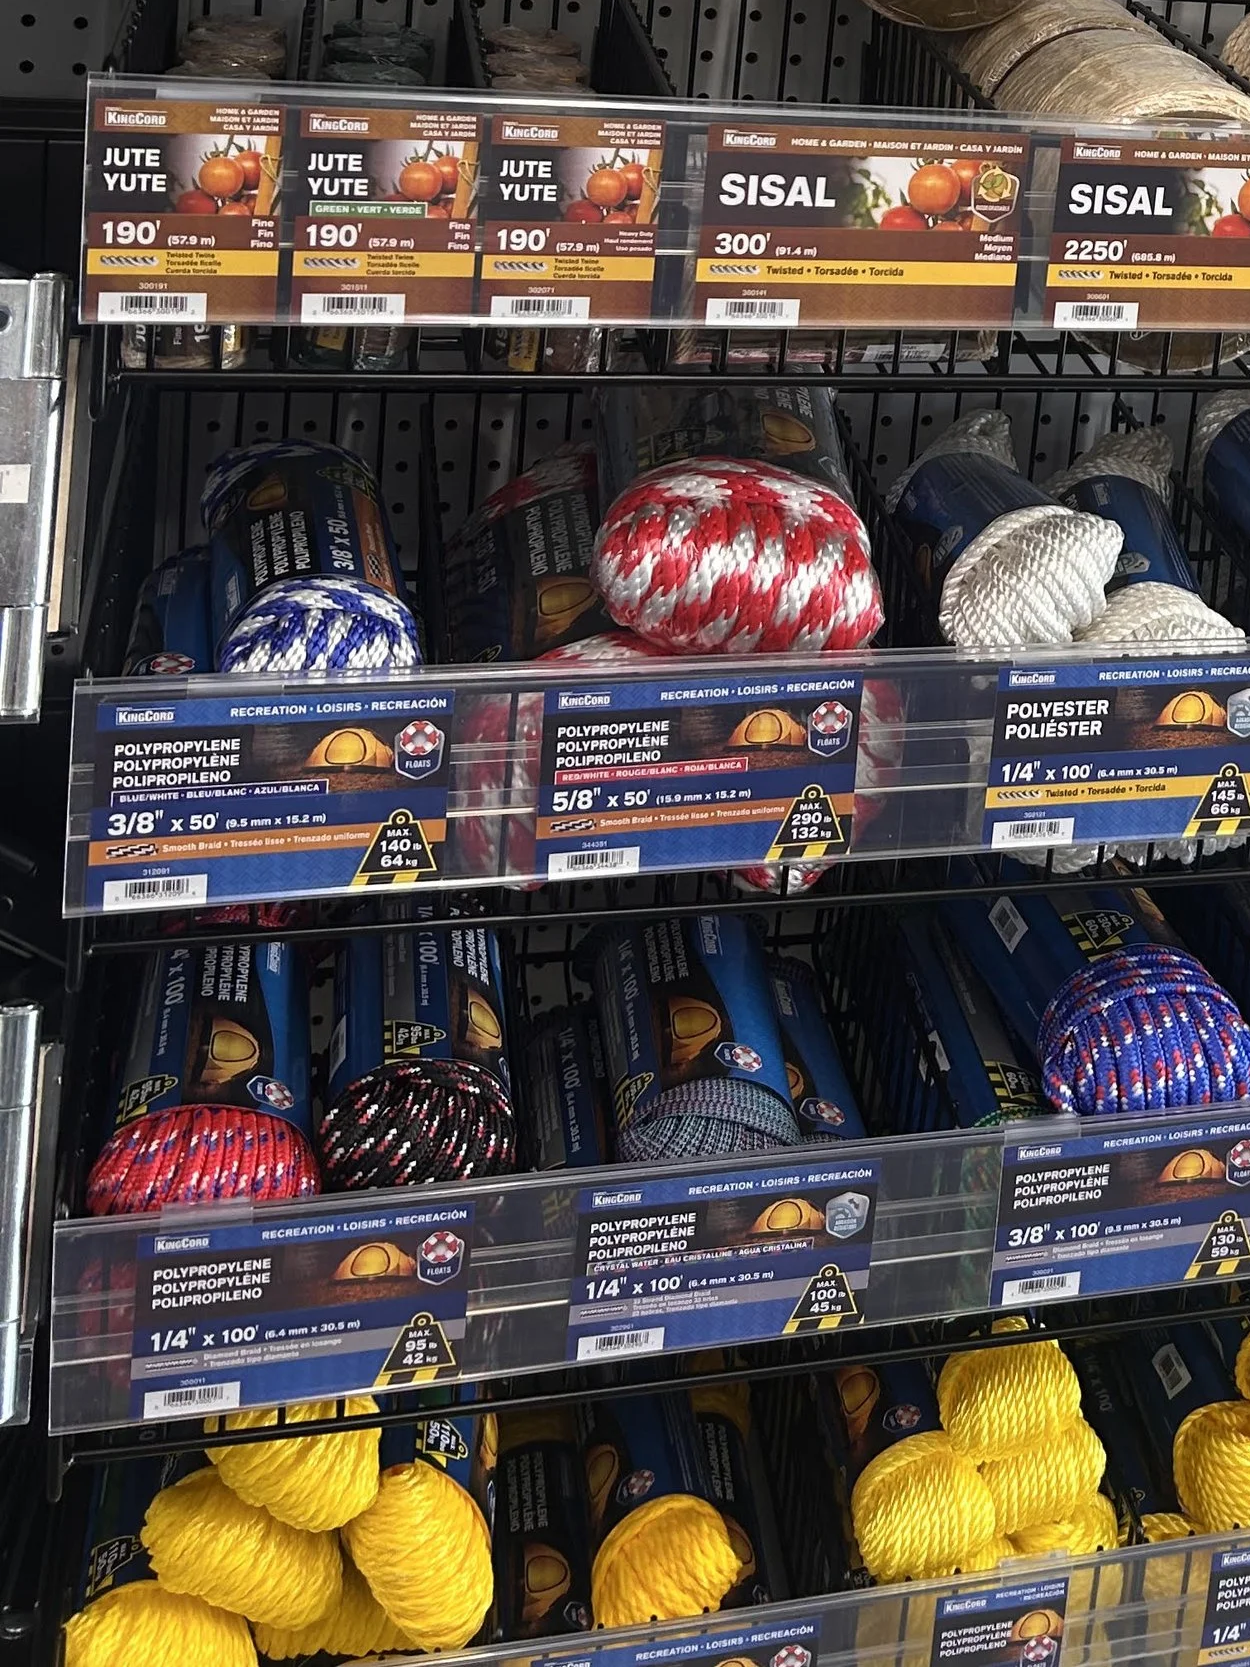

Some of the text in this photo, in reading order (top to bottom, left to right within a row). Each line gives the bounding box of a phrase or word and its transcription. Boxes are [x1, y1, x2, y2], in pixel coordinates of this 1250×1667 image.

[103, 148, 160, 168] JUTE
[104, 172, 167, 192] YUTE
[719, 173, 836, 210] SISAL
[315, 204, 422, 216] GREEN VERT VERDE
[1069, 183, 1173, 216] SISAL
[102, 220, 216, 248] 190' (57.9 m)
[714, 232, 771, 256] 300'
[766, 266, 904, 277] Twisted Torsadée Torcida
[230, 698, 447, 718] RECREATION LOISIRS RECREACIÓN
[1006, 699, 1110, 721] POLYESTER
[1004, 716, 1103, 740] POLIÉSTER
[114, 738, 241, 757] POLYPROPYLENE
[113, 752, 240, 773] POLYPROPYLÈNE
[405, 759, 432, 769] FLOATS
[1001, 759, 1093, 784] 1/4" x 100'
[112, 770, 232, 788] POLIPROPILENO
[119, 783, 320, 803] BLUE/WHITE BLEU/BLANC AZUL/BLANCA
[552, 787, 651, 812] 5/8" x 50'
[108, 810, 220, 835] 3/8" x 50'
[386, 828, 412, 837] MAX.
[379, 838, 422, 853] 140 lb
[380, 854, 418, 868] 64 kg
[1008, 1221, 1101, 1247] 3/8" x 100'
[153, 1258, 272, 1282] POLYPROPYLENE
[150, 1325, 259, 1352] 1/4" x 100'
